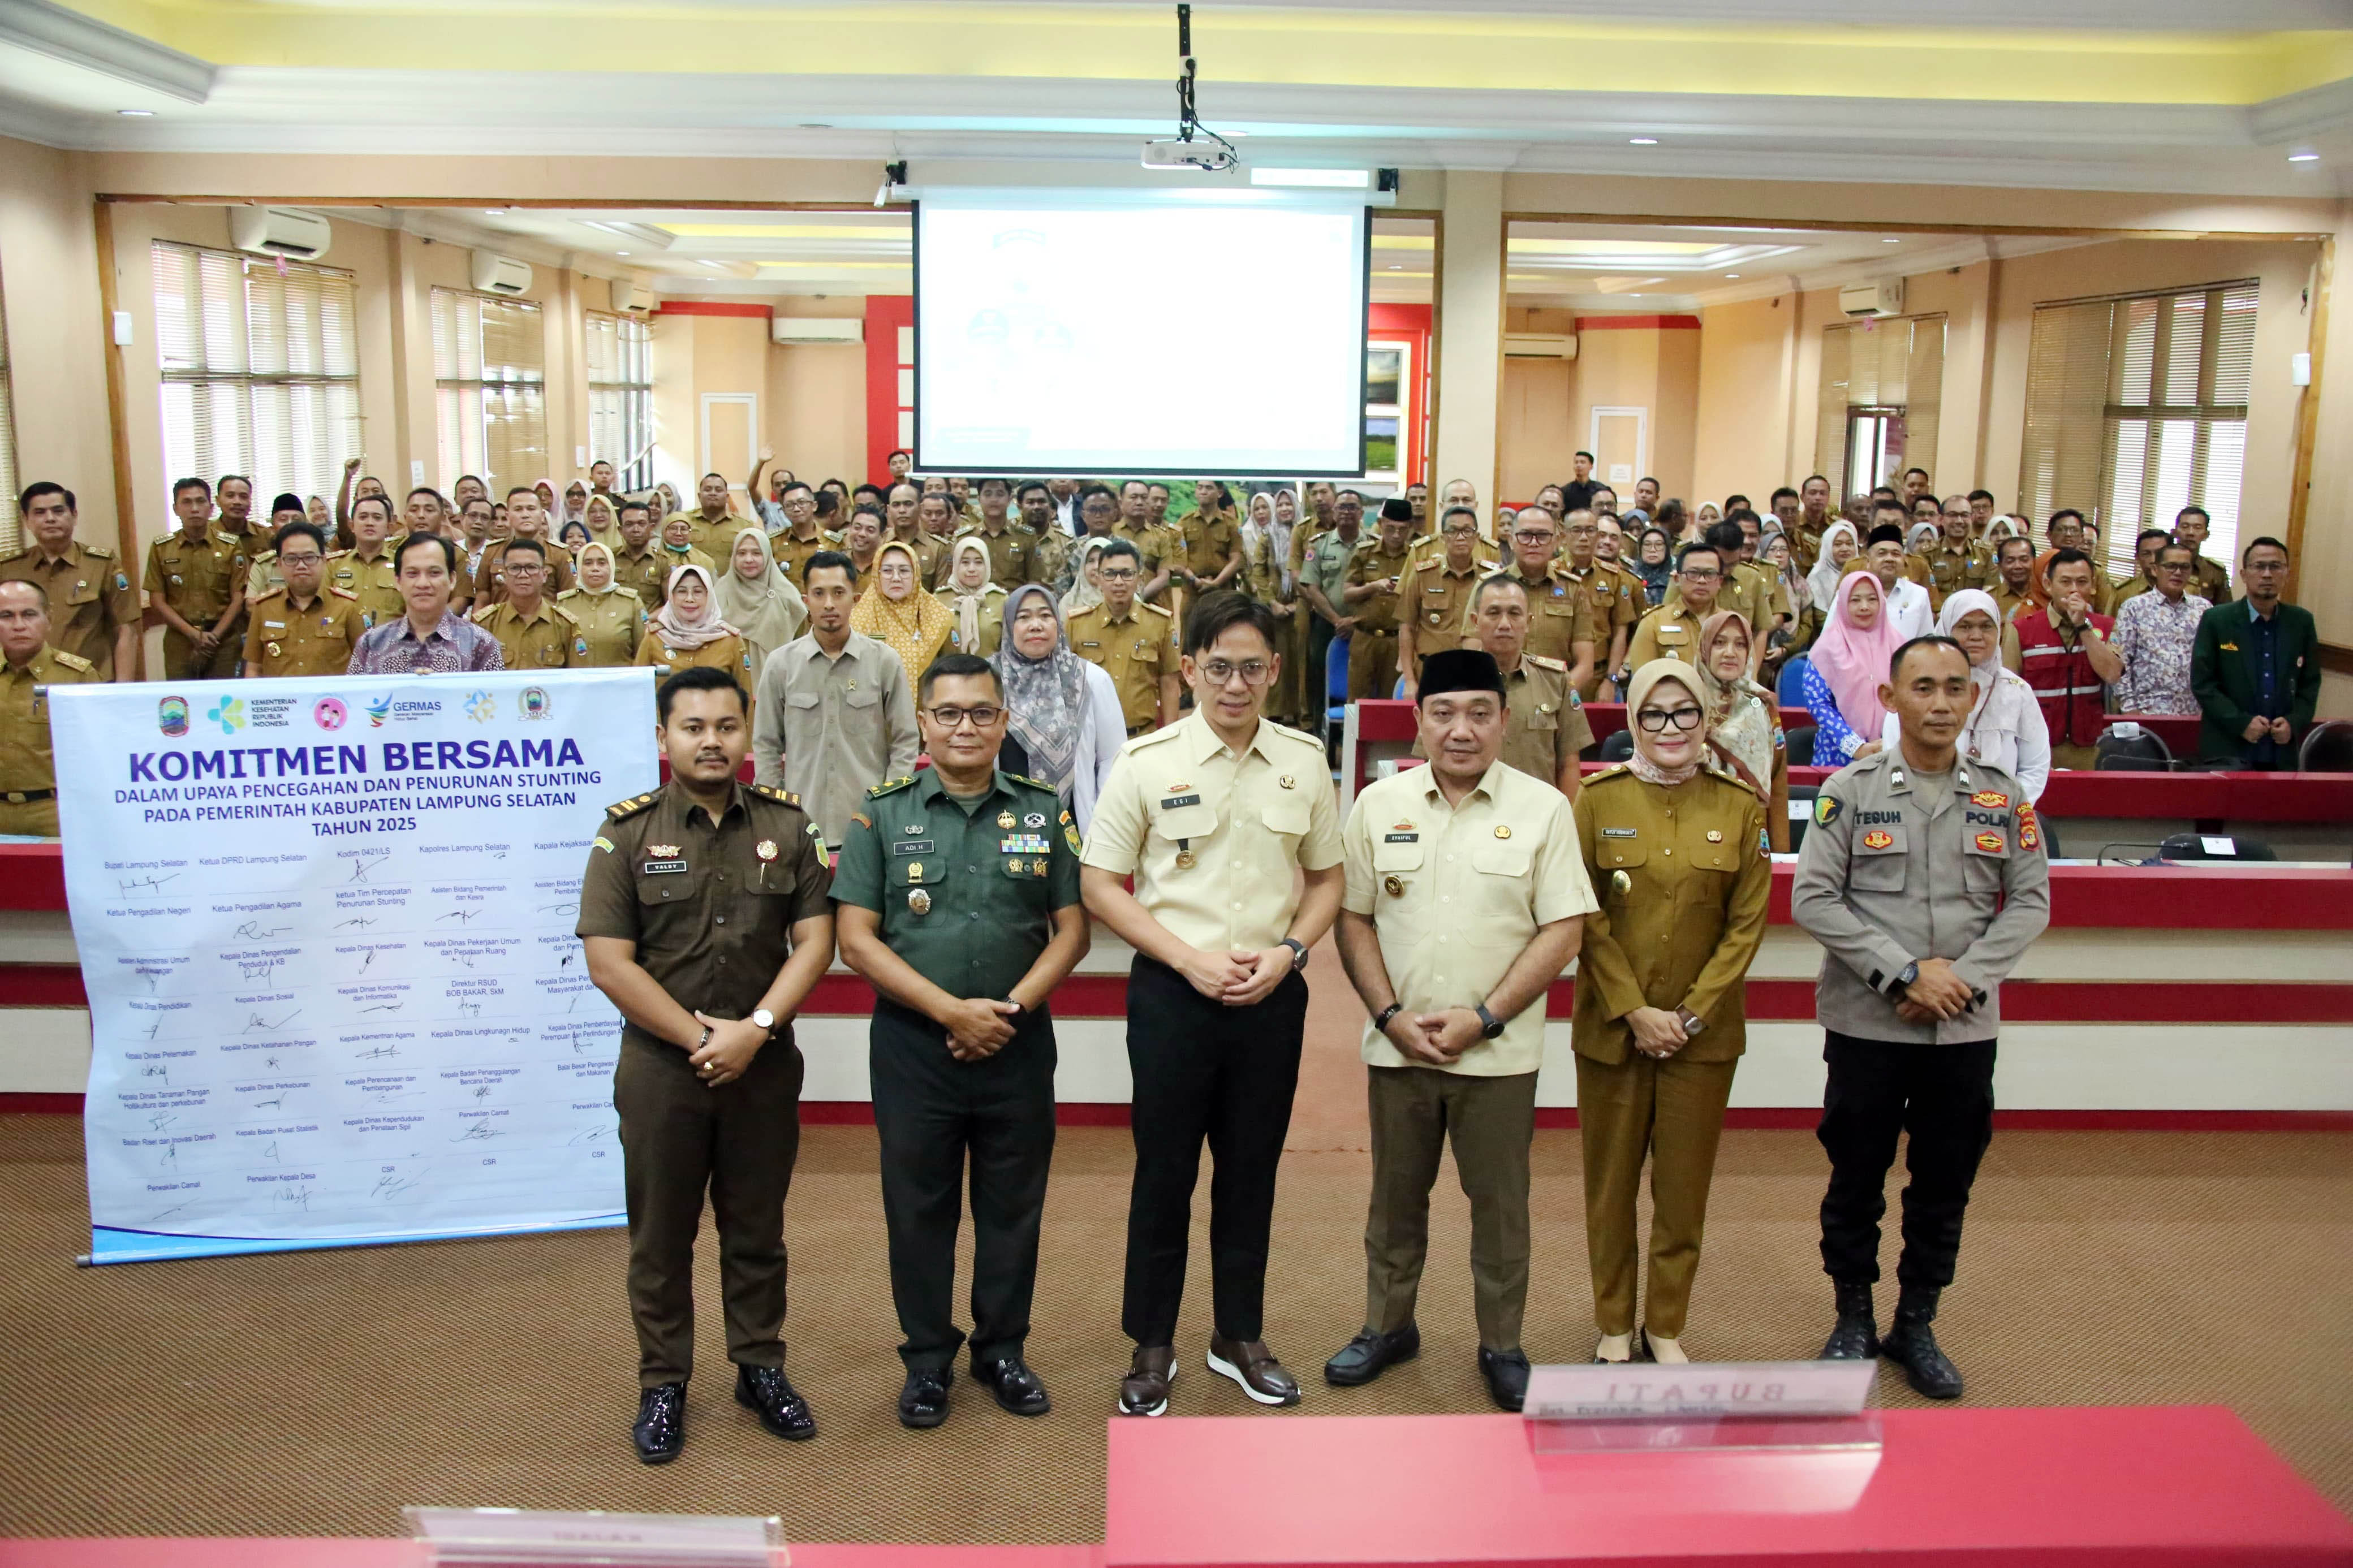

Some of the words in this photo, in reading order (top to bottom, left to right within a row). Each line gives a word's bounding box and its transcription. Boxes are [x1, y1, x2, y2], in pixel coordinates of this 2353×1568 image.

[394, 702, 441, 711] GERMAS
[131, 744, 367, 784] KOMITMEN
[384, 738, 584, 771] BERSAMA
[115, 787, 180, 804] DALAM
[184, 784, 239, 801] UPAYA
[243, 780, 359, 798] PENCEGAHAN
[364, 778, 402, 793] DAN
[406, 774, 514, 791] PENURUNAN
[518, 770, 602, 787] STUNTING
[145, 807, 192, 823] PADA
[196, 802, 308, 820] PEMERINTAH
[311, 798, 413, 816] KABUPATEN
[417, 794, 502, 812] LAMPUNG
[507, 792, 576, 807] SELATAN
[1855, 811, 1901, 825] TEGUH
[1966, 811, 2010, 827] POLRI
[312, 821, 372, 837] TAHUN
[377, 818, 417, 833] 2025
[451, 844, 483, 852] Lampung
[126, 860, 159, 869] Lampung
[222, 856, 244, 865] DPRD
[246, 855, 279, 864] Lampung
[281, 853, 307, 862] Selatan
[454, 885, 473, 894] Bidang
[557, 879, 576, 889] Bidang
[212, 904, 233, 913] Ketua
[277, 900, 301, 909] Agama
[424, 939, 446, 948] Kepala
[485, 947, 506, 956] Ruang
